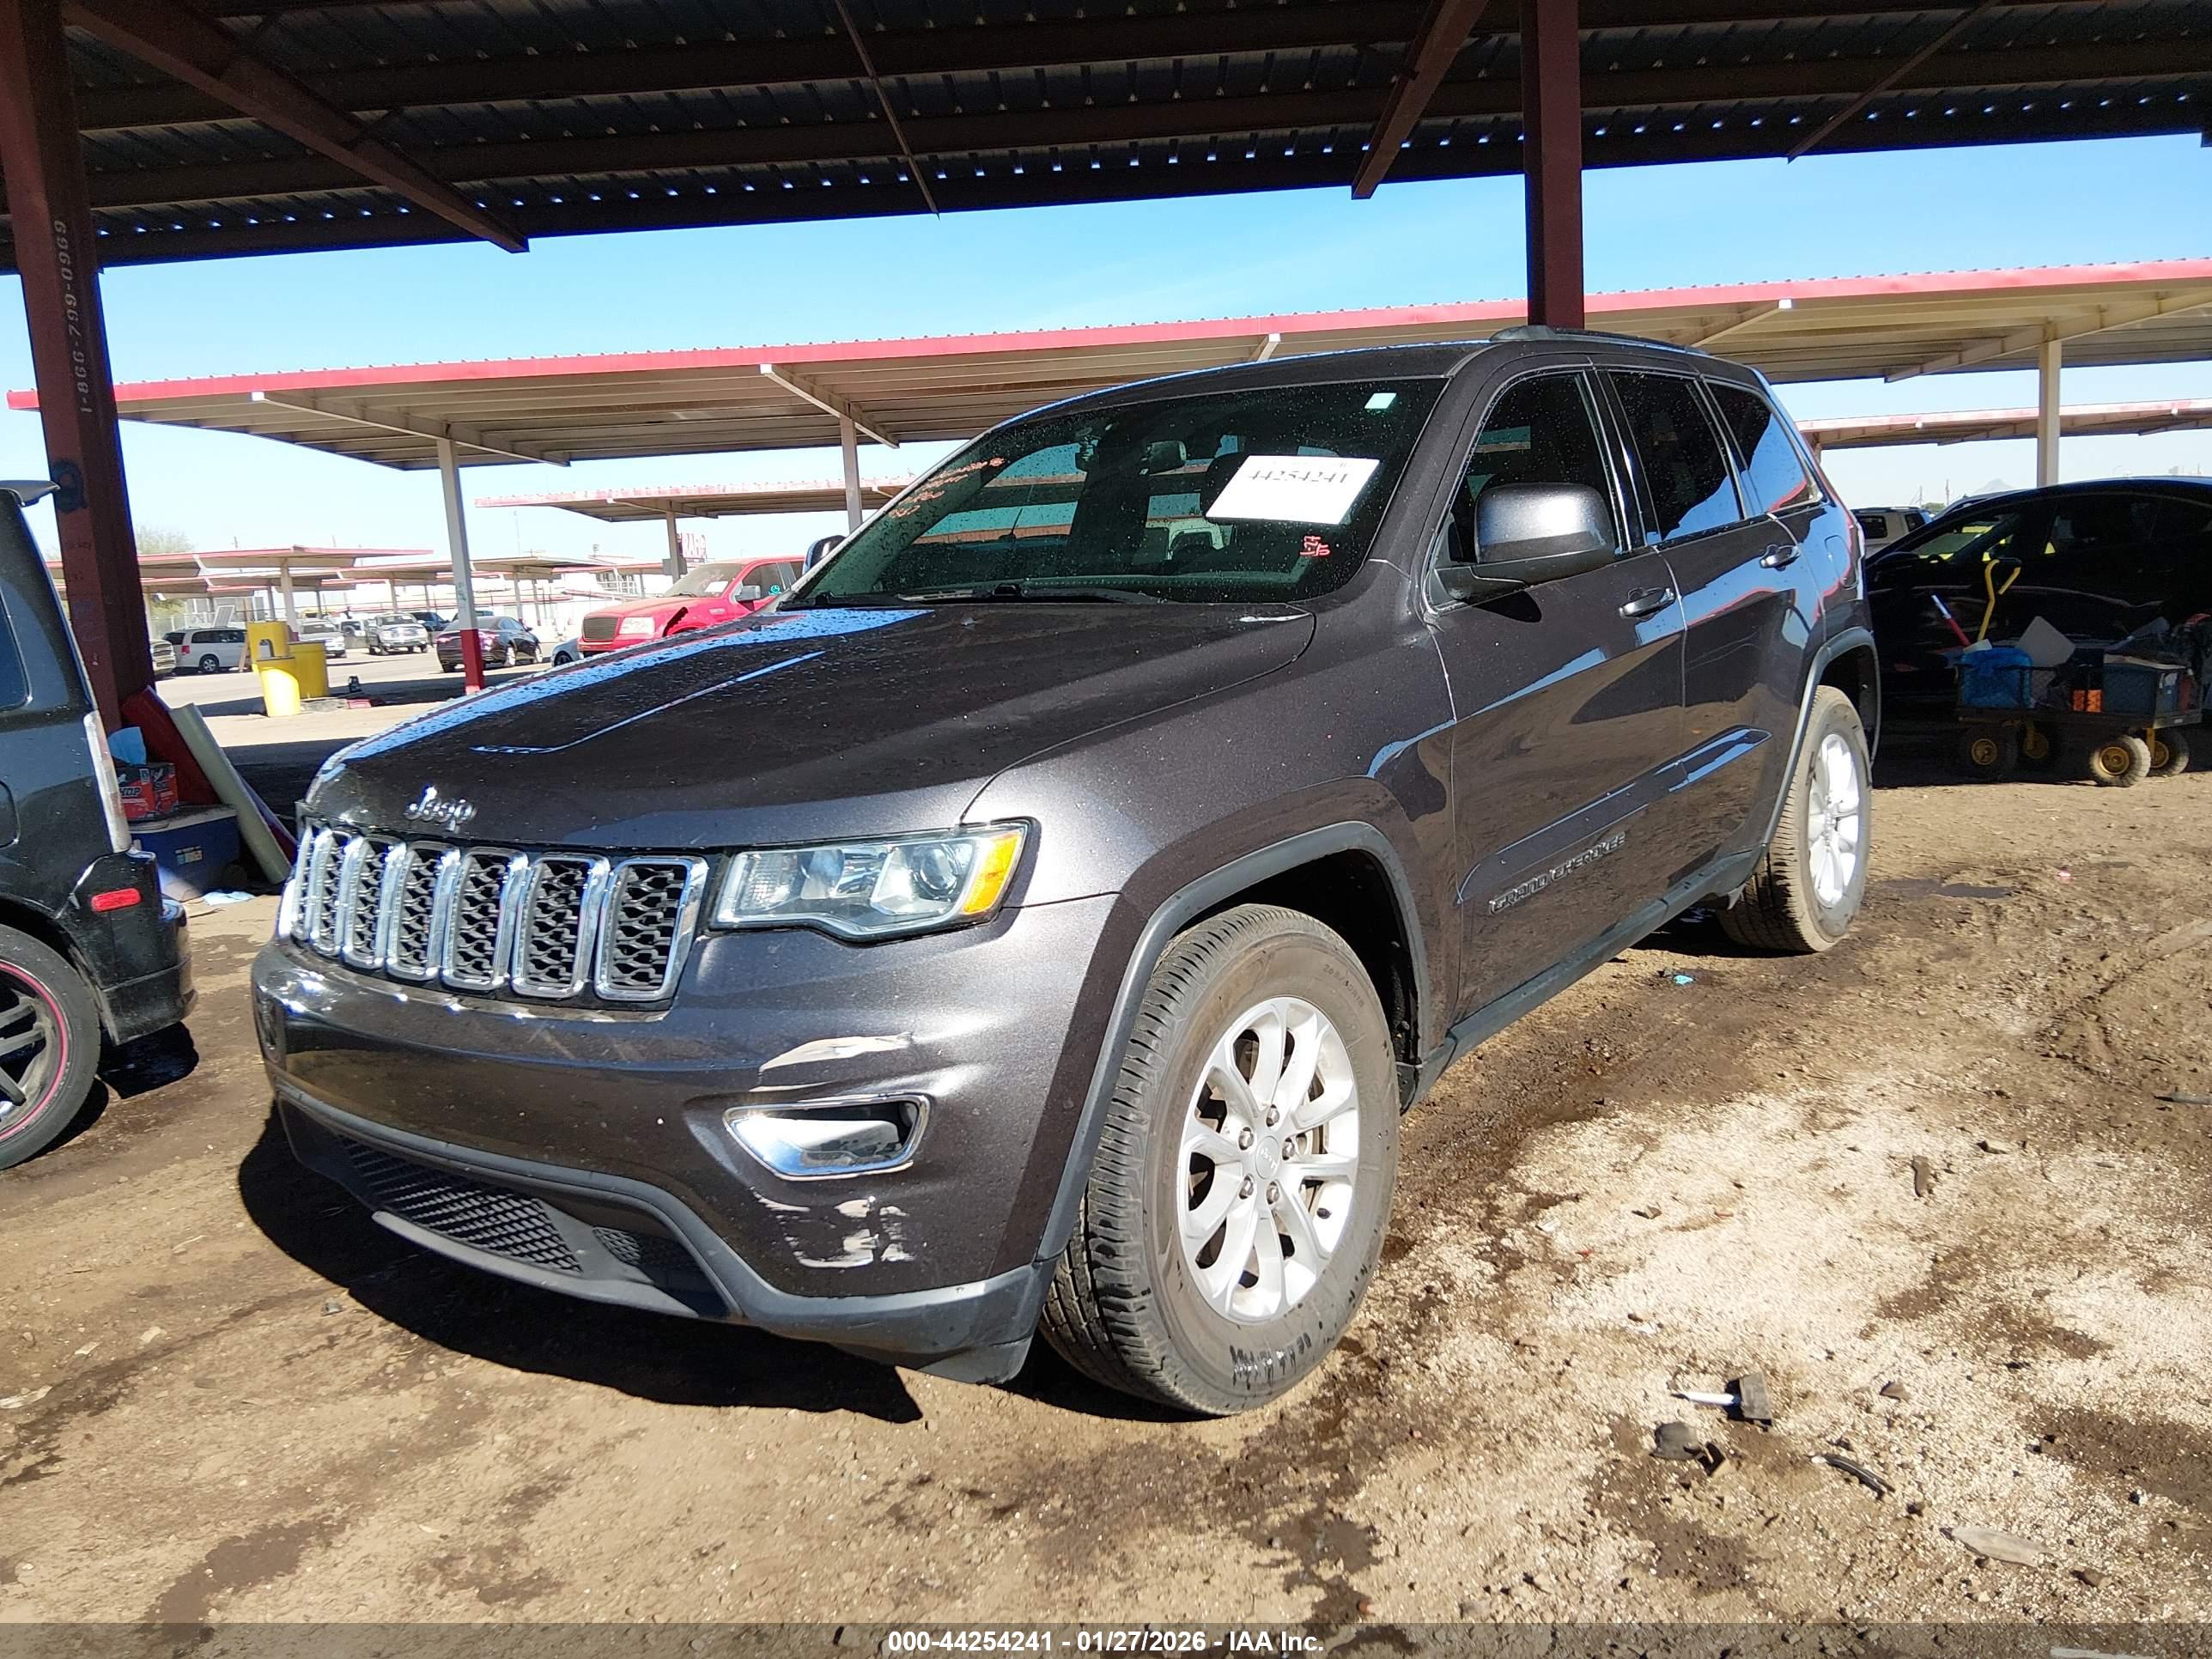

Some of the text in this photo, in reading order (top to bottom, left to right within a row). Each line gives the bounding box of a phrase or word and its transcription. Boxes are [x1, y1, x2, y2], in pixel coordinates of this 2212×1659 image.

[54, 220, 93, 414] 1-866-799-0969
[118, 786, 142, 798] HOP
[404, 784, 477, 834] Jeep
[1488, 831, 1626, 914] GRAND CHEROKEE
